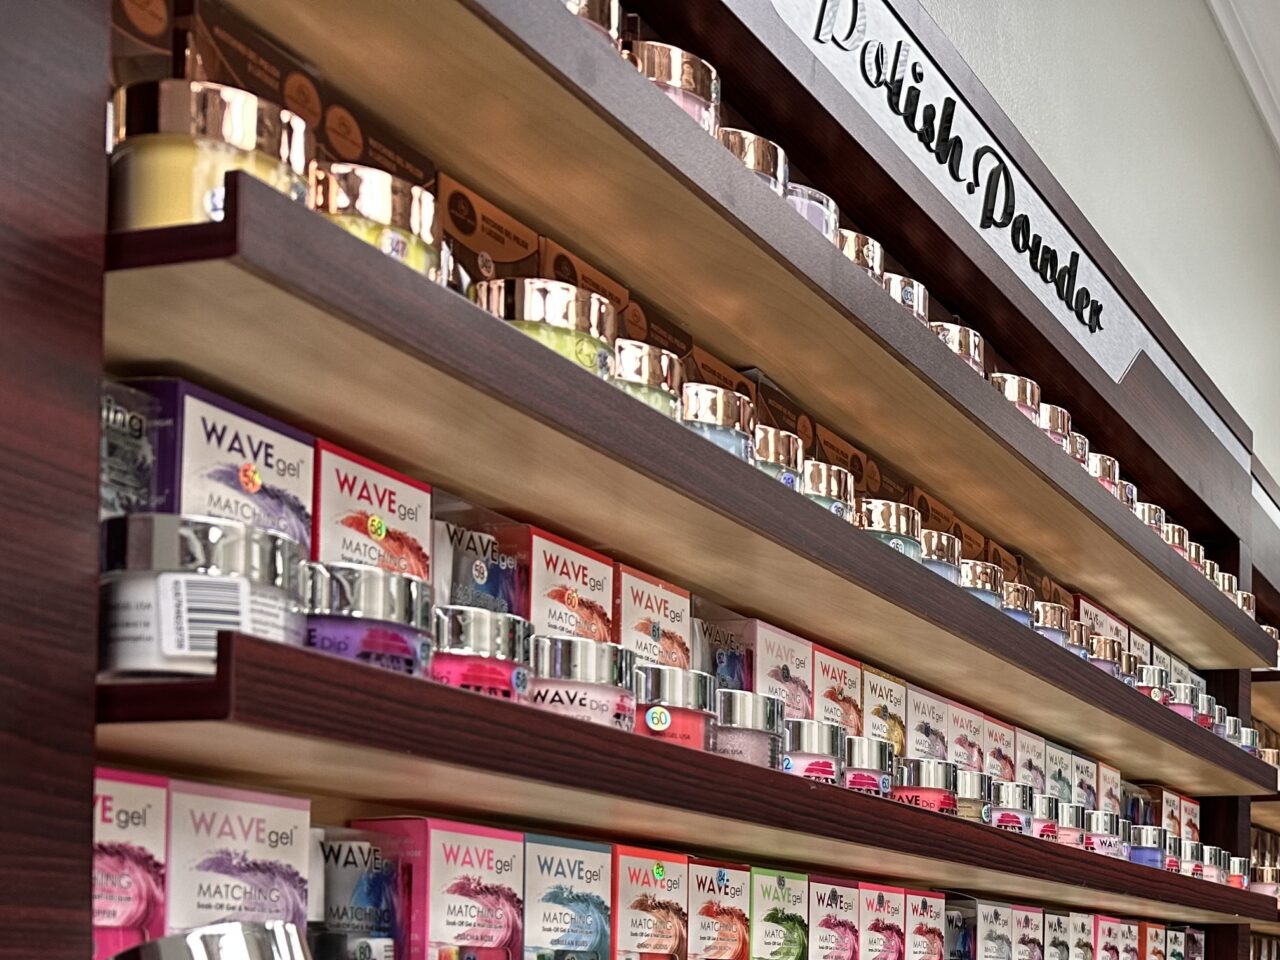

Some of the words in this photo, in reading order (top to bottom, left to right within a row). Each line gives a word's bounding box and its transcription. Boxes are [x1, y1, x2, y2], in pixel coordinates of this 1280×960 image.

[966, 145, 1104, 333] Powder
[201, 416, 301, 480] WAVEgel
[335, 468, 420, 523] WAVEgel
[341, 537, 408, 571] MATCHING
[543, 550, 604, 593] WAVEgel
[631, 585, 683, 623] WAVEgel
[548, 608, 597, 634] MATCHING
[635, 640, 677, 663] MATCHING
[764, 639, 806, 669] WAVEgel
[821, 661, 856, 690] WAVEgel
[869, 681, 902, 707] WAVEgel
[650, 711, 667, 726] 60
[913, 700, 943, 723] WAVEgel
[952, 713, 980, 735] WAVEgel
[93, 794, 147, 829] Egel
[189, 808, 294, 848] WAVEgel
[442, 843, 513, 875] WAVEgel
[537, 854, 601, 883] WAVEgel
[197, 884, 280, 903] MATCHING
[447, 904, 503, 920] MATCHING
[542, 912, 593, 926] MATCHING
[631, 918, 672, 930] MATCHING
